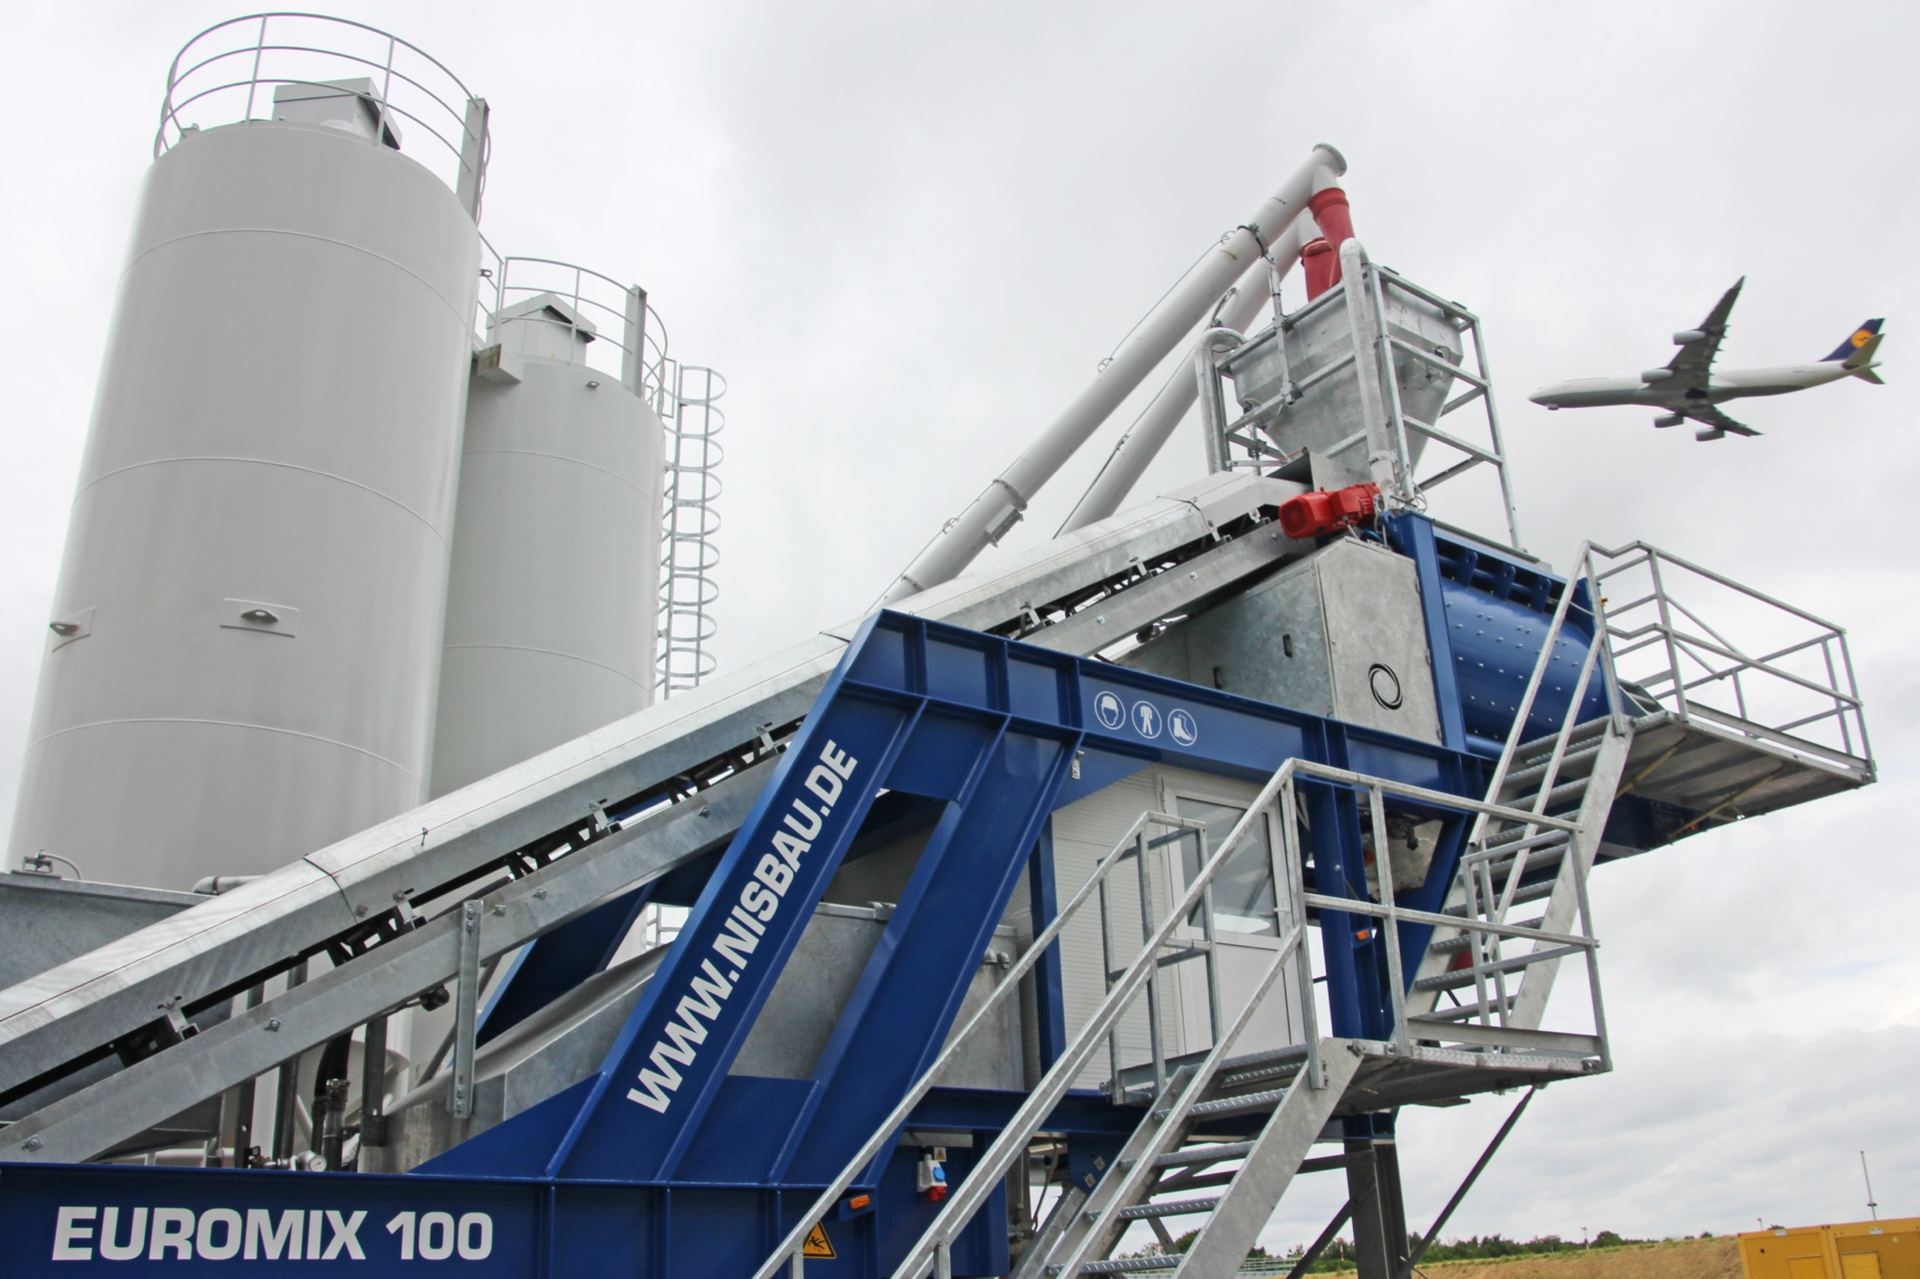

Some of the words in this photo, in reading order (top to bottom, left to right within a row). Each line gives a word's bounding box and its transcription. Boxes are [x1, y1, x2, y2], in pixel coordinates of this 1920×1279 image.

[626, 739, 858, 1114] WWW.NISBAU.DE
[52, 1206, 368, 1261] EUROMIX
[386, 1212, 493, 1260] 100
